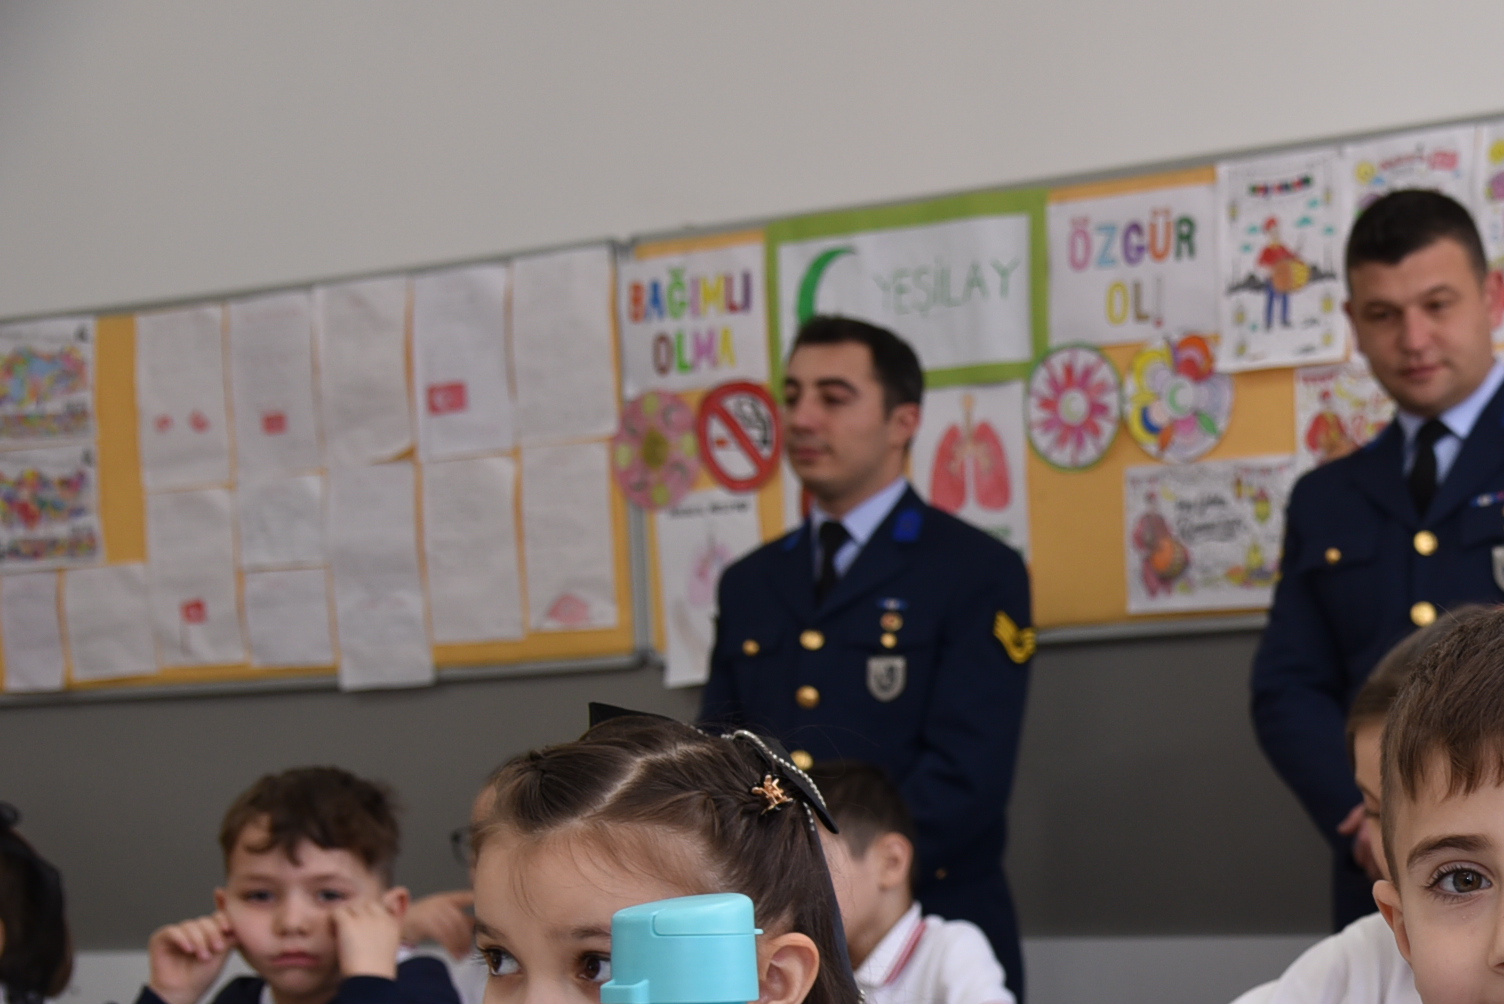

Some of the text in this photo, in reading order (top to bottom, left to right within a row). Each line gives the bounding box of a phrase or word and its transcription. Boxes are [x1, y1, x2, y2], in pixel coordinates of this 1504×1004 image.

[1069, 207, 1197, 271] ÖZGÜR
[629, 267, 752, 324] BAĞIMLI
[873, 254, 1021, 318] YEŞİLAY
[653, 326, 736, 377] OLMA
